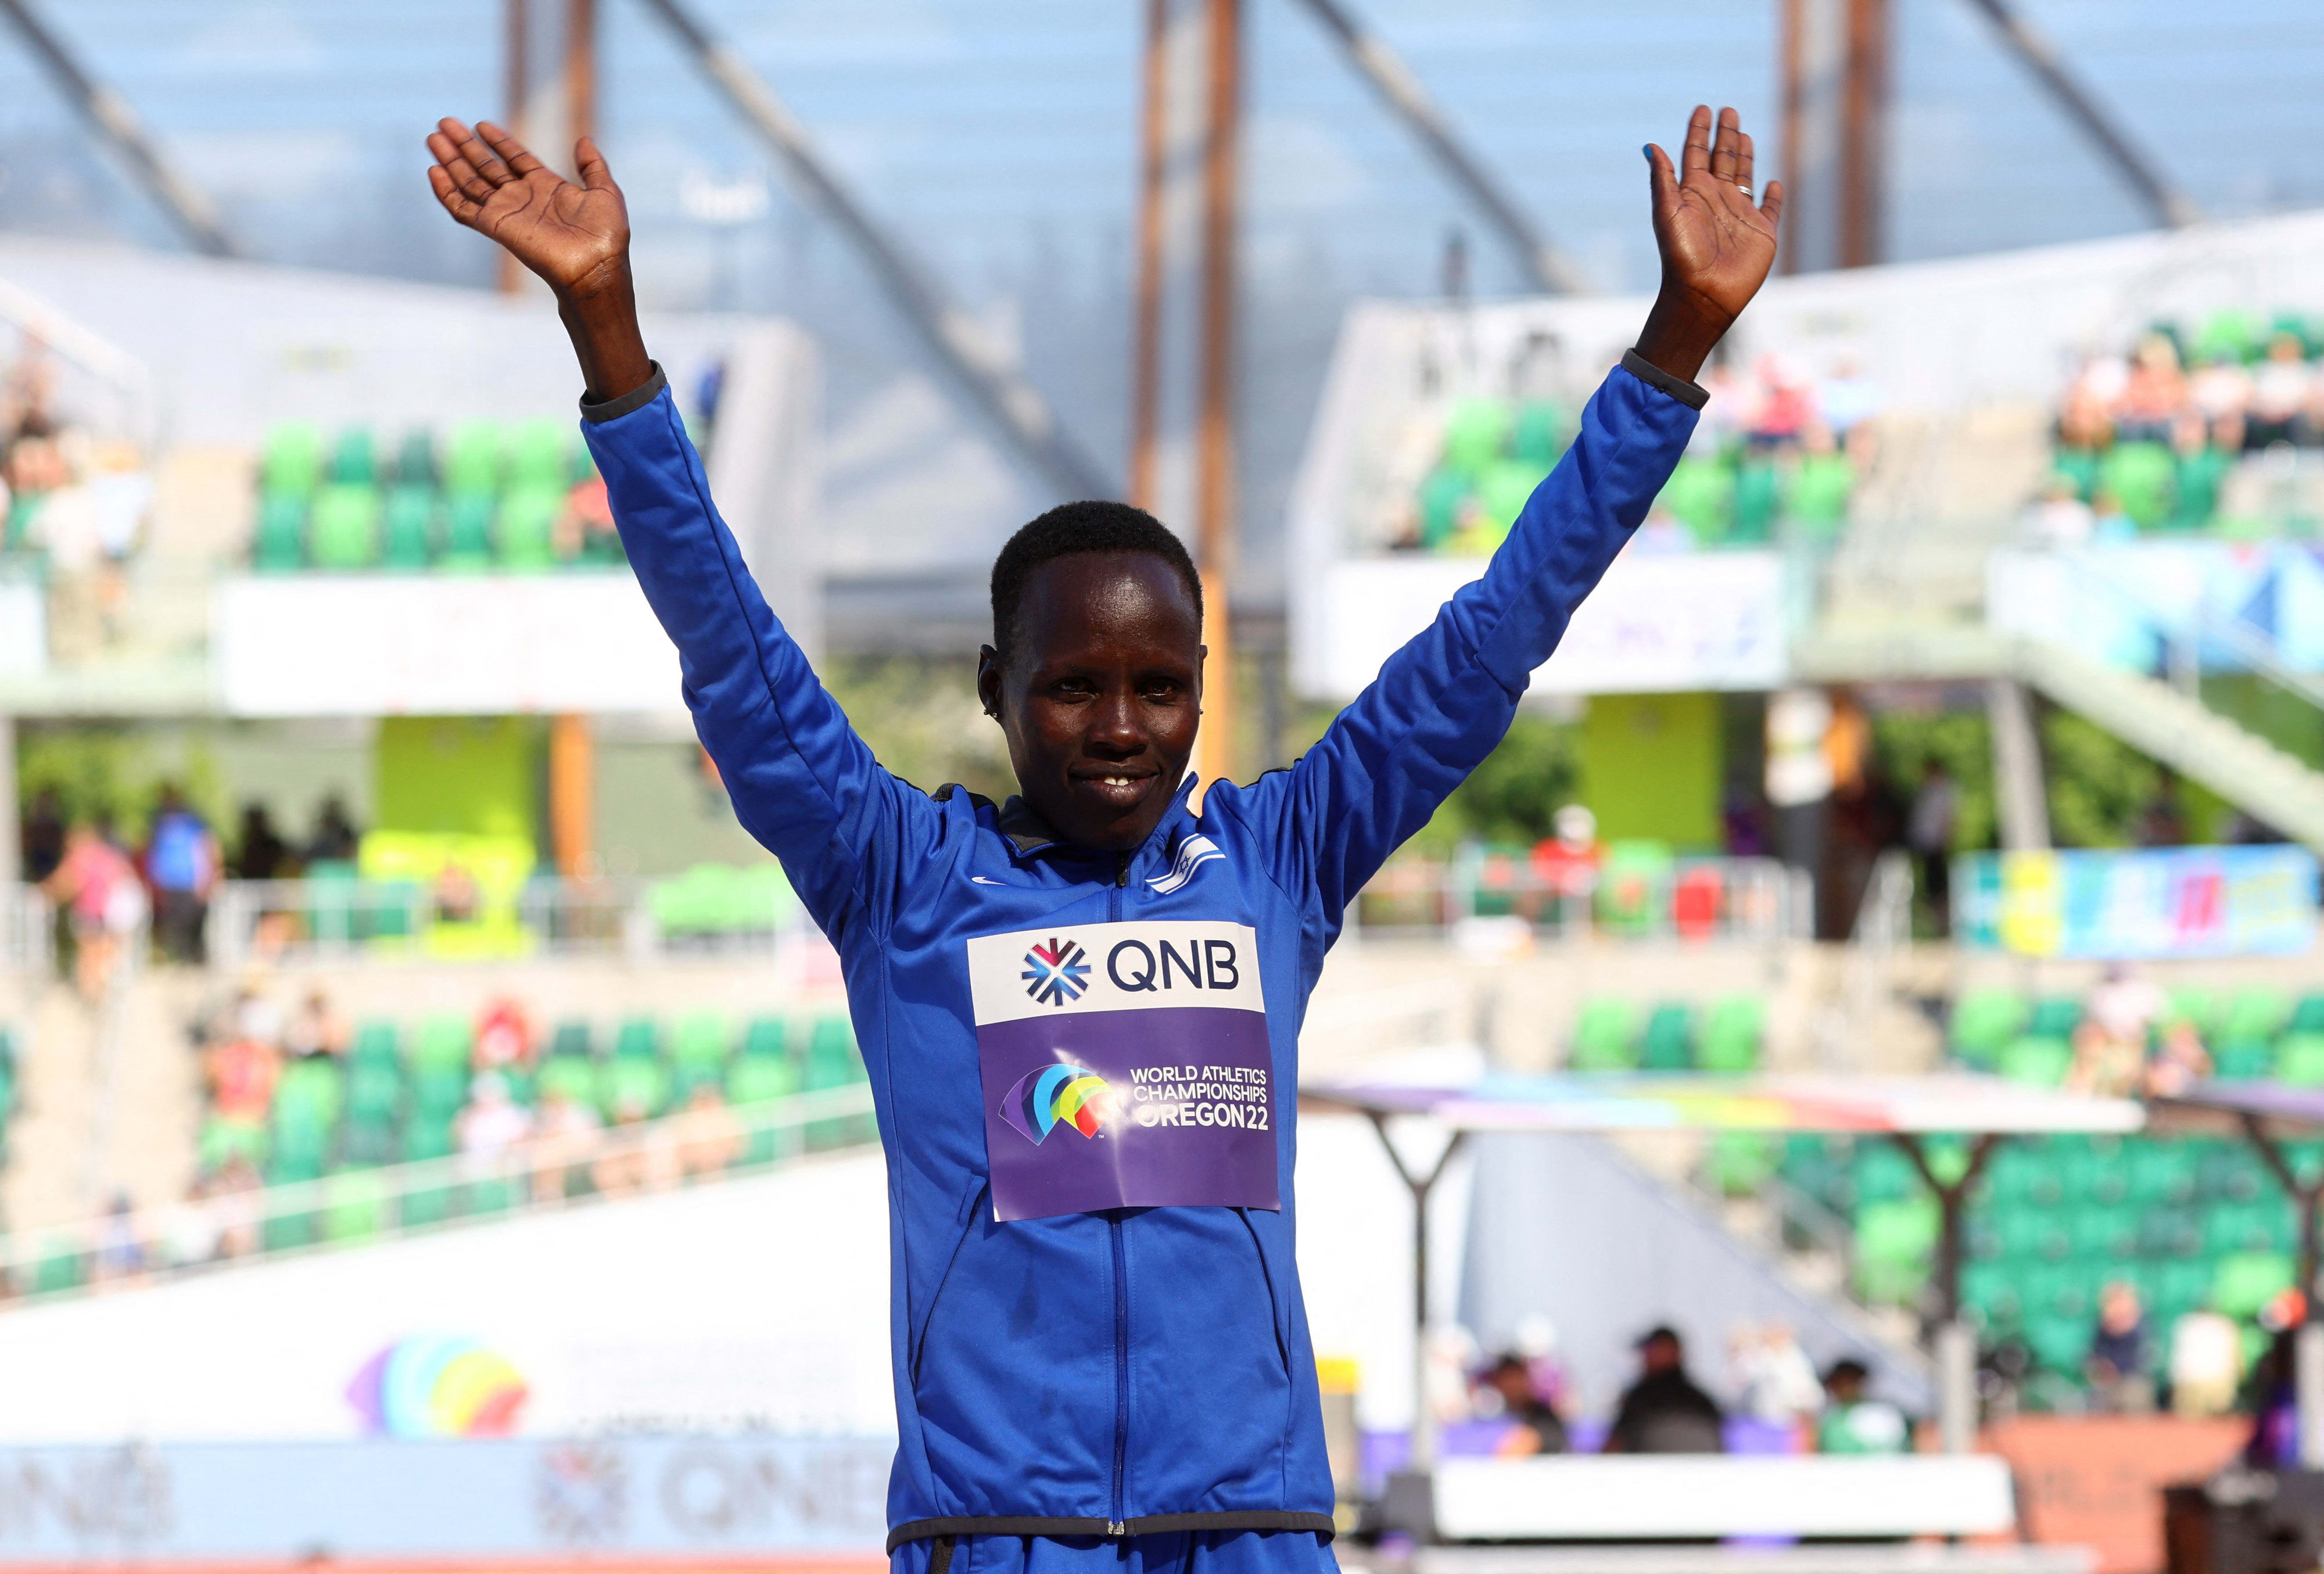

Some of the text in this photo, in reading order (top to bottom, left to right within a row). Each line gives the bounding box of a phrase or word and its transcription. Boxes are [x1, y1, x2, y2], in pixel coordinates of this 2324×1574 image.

[1107, 939, 1239, 992] QNB
[1129, 1065, 1267, 1085] WORLD ATHLETICS
[1133, 1082, 1267, 1104] CHAMPIONSHIPS
[1135, 1102, 1268, 1131] OREGON22
